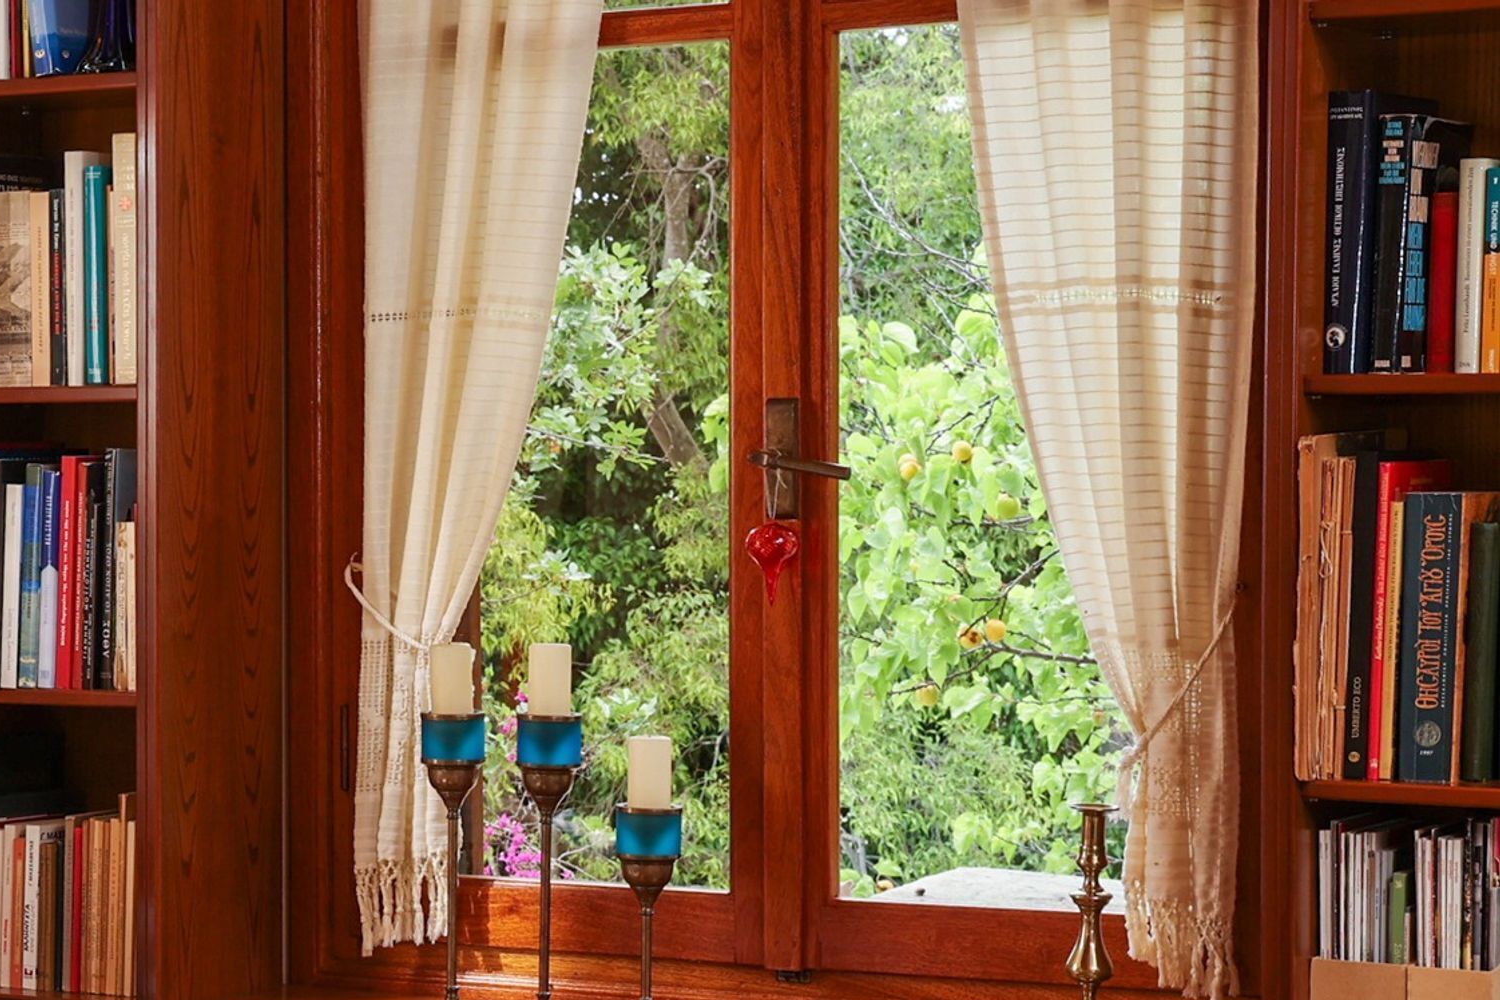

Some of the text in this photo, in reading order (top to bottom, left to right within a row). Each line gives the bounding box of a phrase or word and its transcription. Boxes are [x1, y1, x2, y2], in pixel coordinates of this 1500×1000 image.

[1332, 147, 1345, 307] ΑΡΧΑΙΟΙ ΕΛΛΗΝΕΣ ΘΕΤΙΚΟΙ ΕΠΙΣΤΗΜΟΝΕΣ
[1489, 200, 1499, 276] TECHNIK UND ANGST
[105, 600, 111, 613] ΤΟ
[102, 620, 111, 658] ΑΘΩΣ
[1350, 677, 1362, 738] UMBERTO ECO
